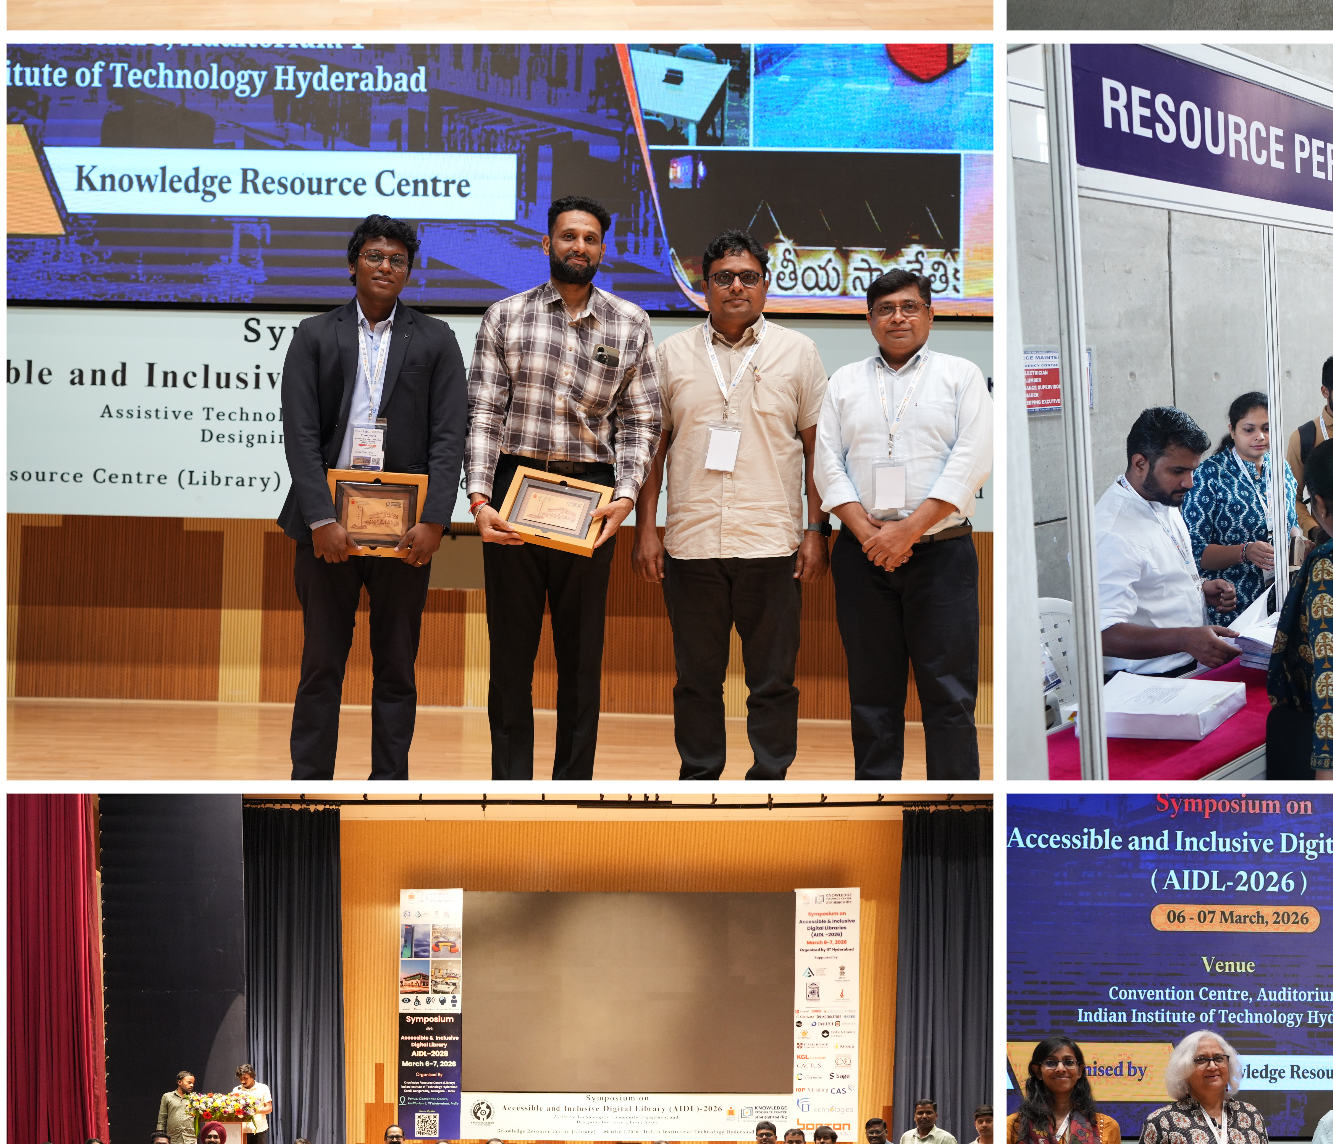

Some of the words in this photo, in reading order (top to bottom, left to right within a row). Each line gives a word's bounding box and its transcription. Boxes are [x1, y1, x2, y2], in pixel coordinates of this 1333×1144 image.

[76, 62, 101, 88] of
[110, 62, 267, 97] Technology
[275, 65, 427, 97] Hyderabad
[1102, 77, 1284, 169] RESOURCE
[76, 165, 232, 202] Knowledge
[240, 168, 366, 197] Resource
[374, 170, 471, 197] Centre
[70, 362, 128, 387] and
[101, 405, 194, 422] Assistive
[93, 469, 168, 486] Centre
[178, 470, 281, 491] (Library)
[1007, 828, 1122, 851] Accessible
[1129, 830, 1170, 851] and
[1175, 831, 1274, 853] Inclusive
[1202, 957, 1255, 973] Venue
[1109, 986, 1195, 1002] Convention
[1199, 986, 1253, 1003] Centre,
[406, 1015, 454, 1024] Symposium
[603, 1105, 632, 1113] Digital
[635, 1105, 666, 1113] Library
